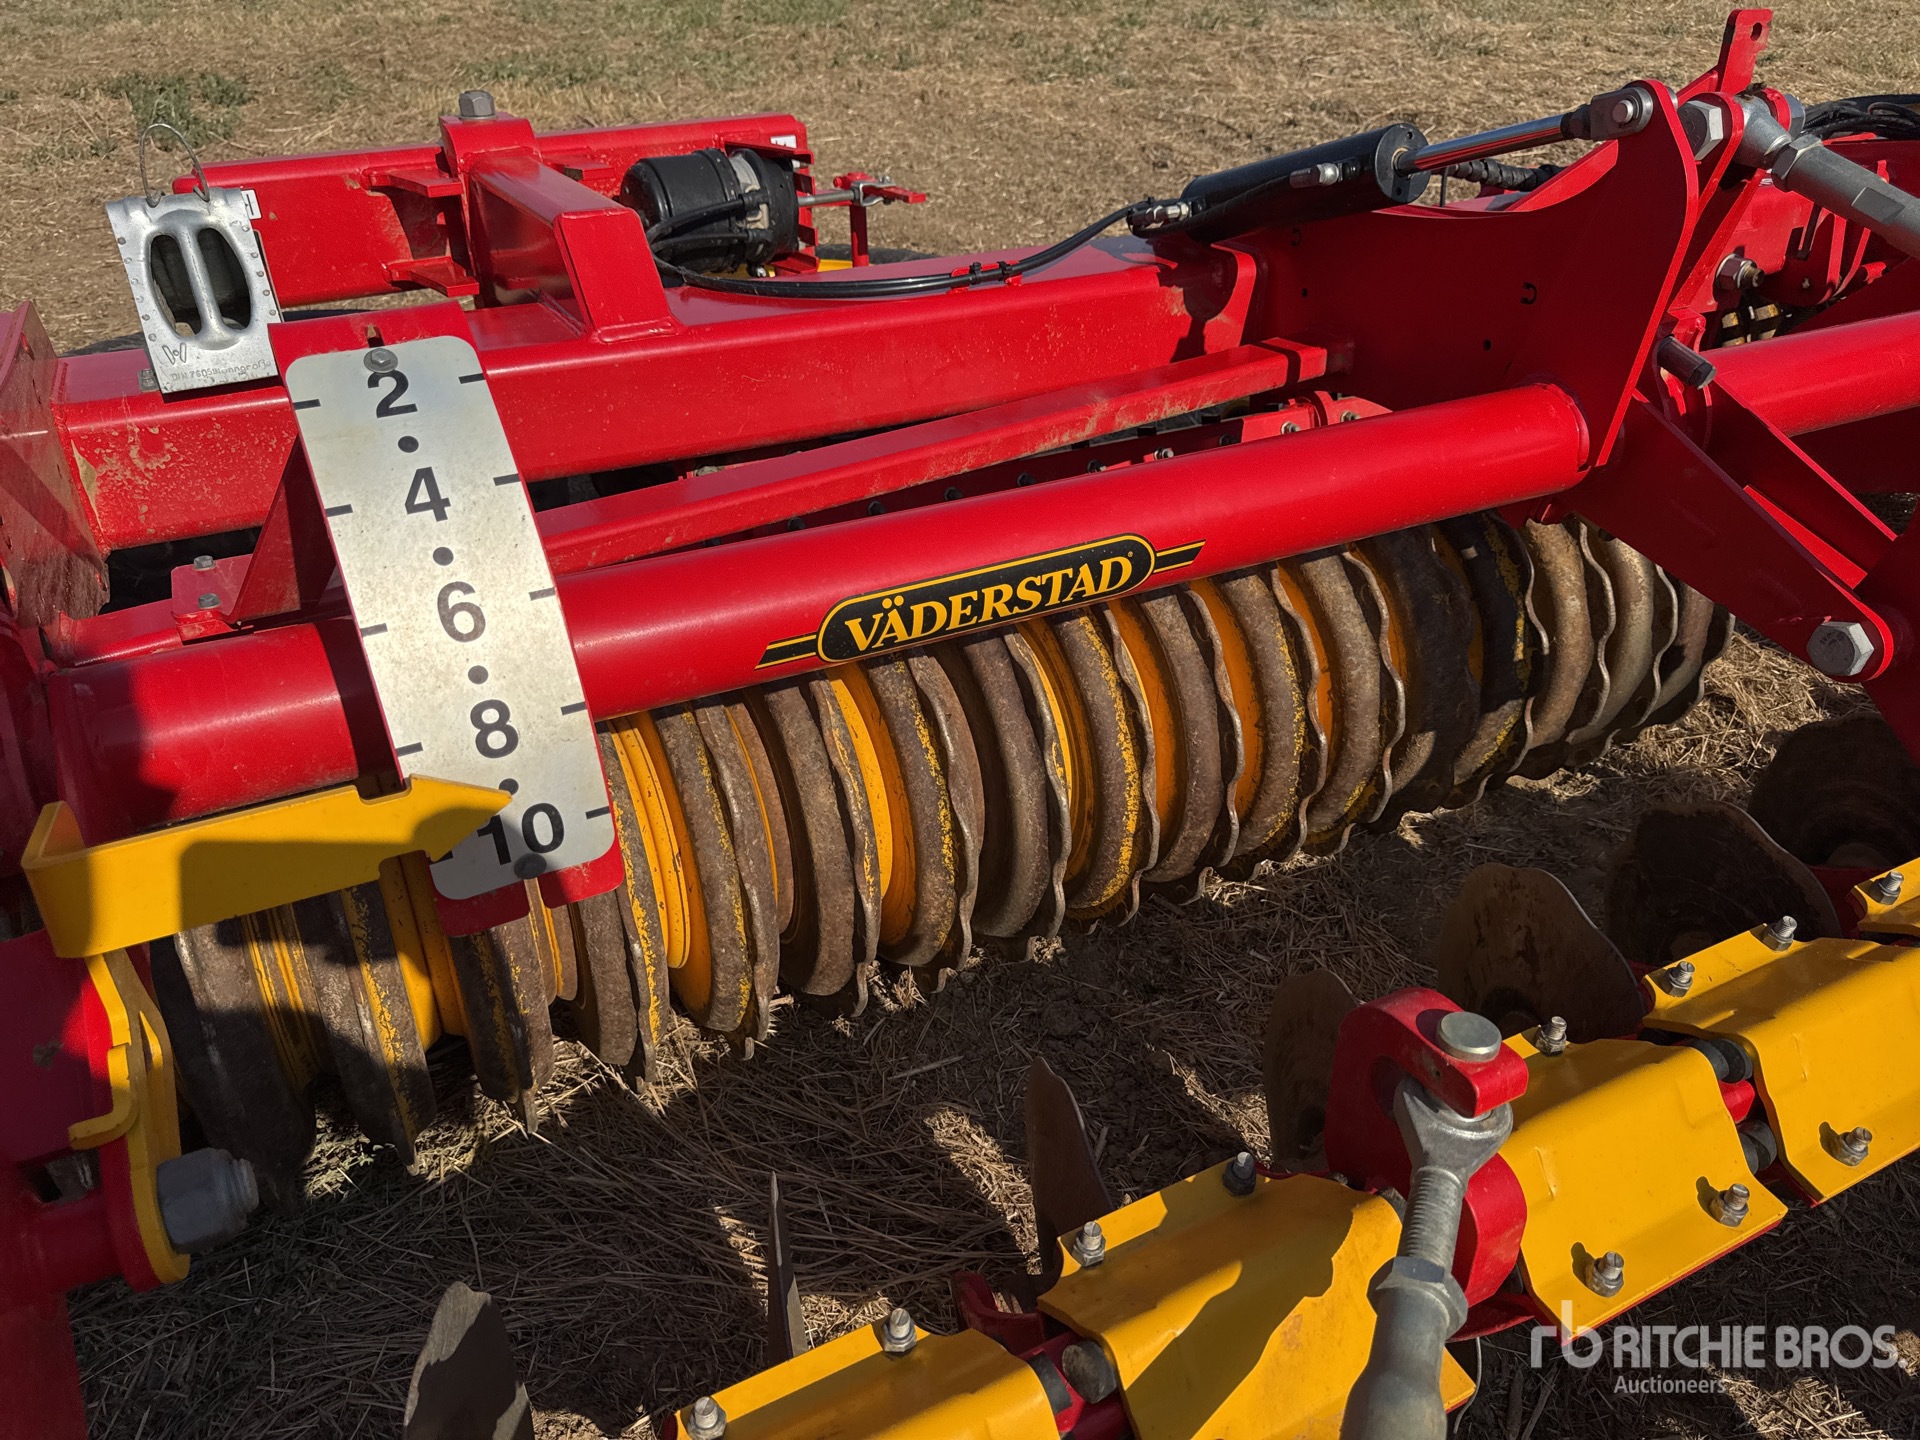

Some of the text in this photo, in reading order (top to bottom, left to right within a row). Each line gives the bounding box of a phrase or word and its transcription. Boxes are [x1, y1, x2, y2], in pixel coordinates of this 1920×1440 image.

[367, 370, 418, 419] 2
[405, 466, 451, 522] 4
[437, 581, 487, 643] 6
[844, 555, 1132, 652] VÄDERSTAD
[470, 699, 520, 759] 8
[477, 803, 565, 865] 10
